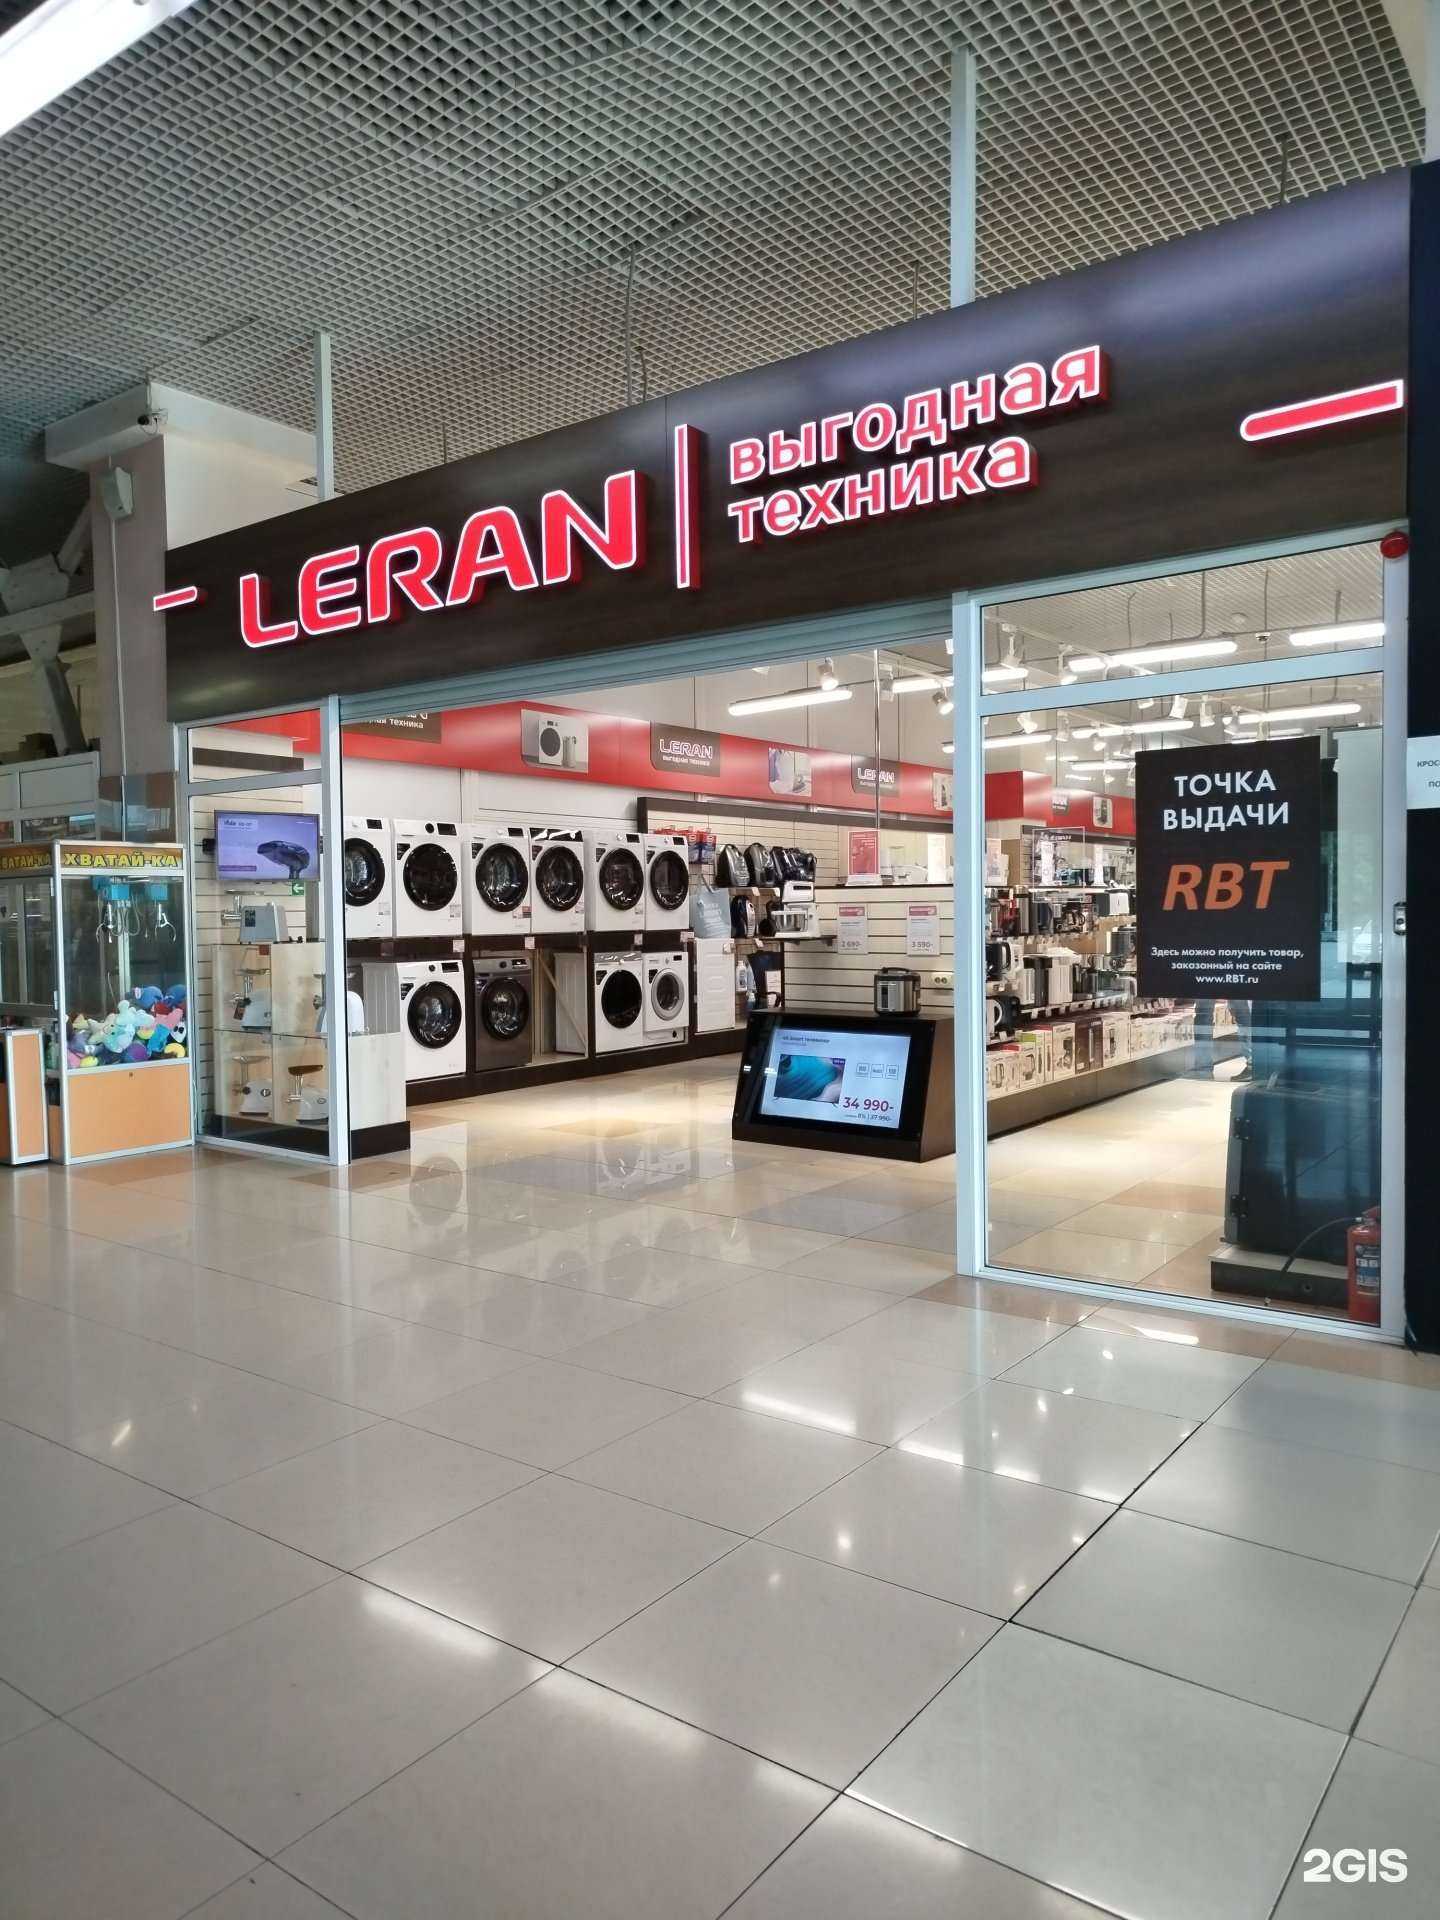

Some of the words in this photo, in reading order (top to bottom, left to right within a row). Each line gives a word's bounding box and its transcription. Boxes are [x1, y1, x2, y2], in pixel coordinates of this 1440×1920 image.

[729, 344, 1101, 485] выгодная
[727, 436, 1031, 544] техника
[239, 470, 637, 648] LERAN
[659, 739, 713, 760] LERAN
[1173, 769, 1277, 797] ТОЧКА
[1163, 801, 1289, 833] ВЫДАЧИ
[64, 851, 178, 868] ХВАТАЙ-КА
[1162, 860, 1290, 911] RBT
[1151, 946, 1180, 957] Здесь
[1181, 948, 1216, 957] можно
[1218, 948, 1267, 959] получить
[1268, 948, 1304, 959] товар,
[1170, 961, 1234, 970] заказанный
[1251, 961, 1283, 971] сайте
[1195, 974, 1259, 984] www.RBT.ru
[842, 1096, 860, 1109] 34
[863, 1098, 894, 1112] 990-
